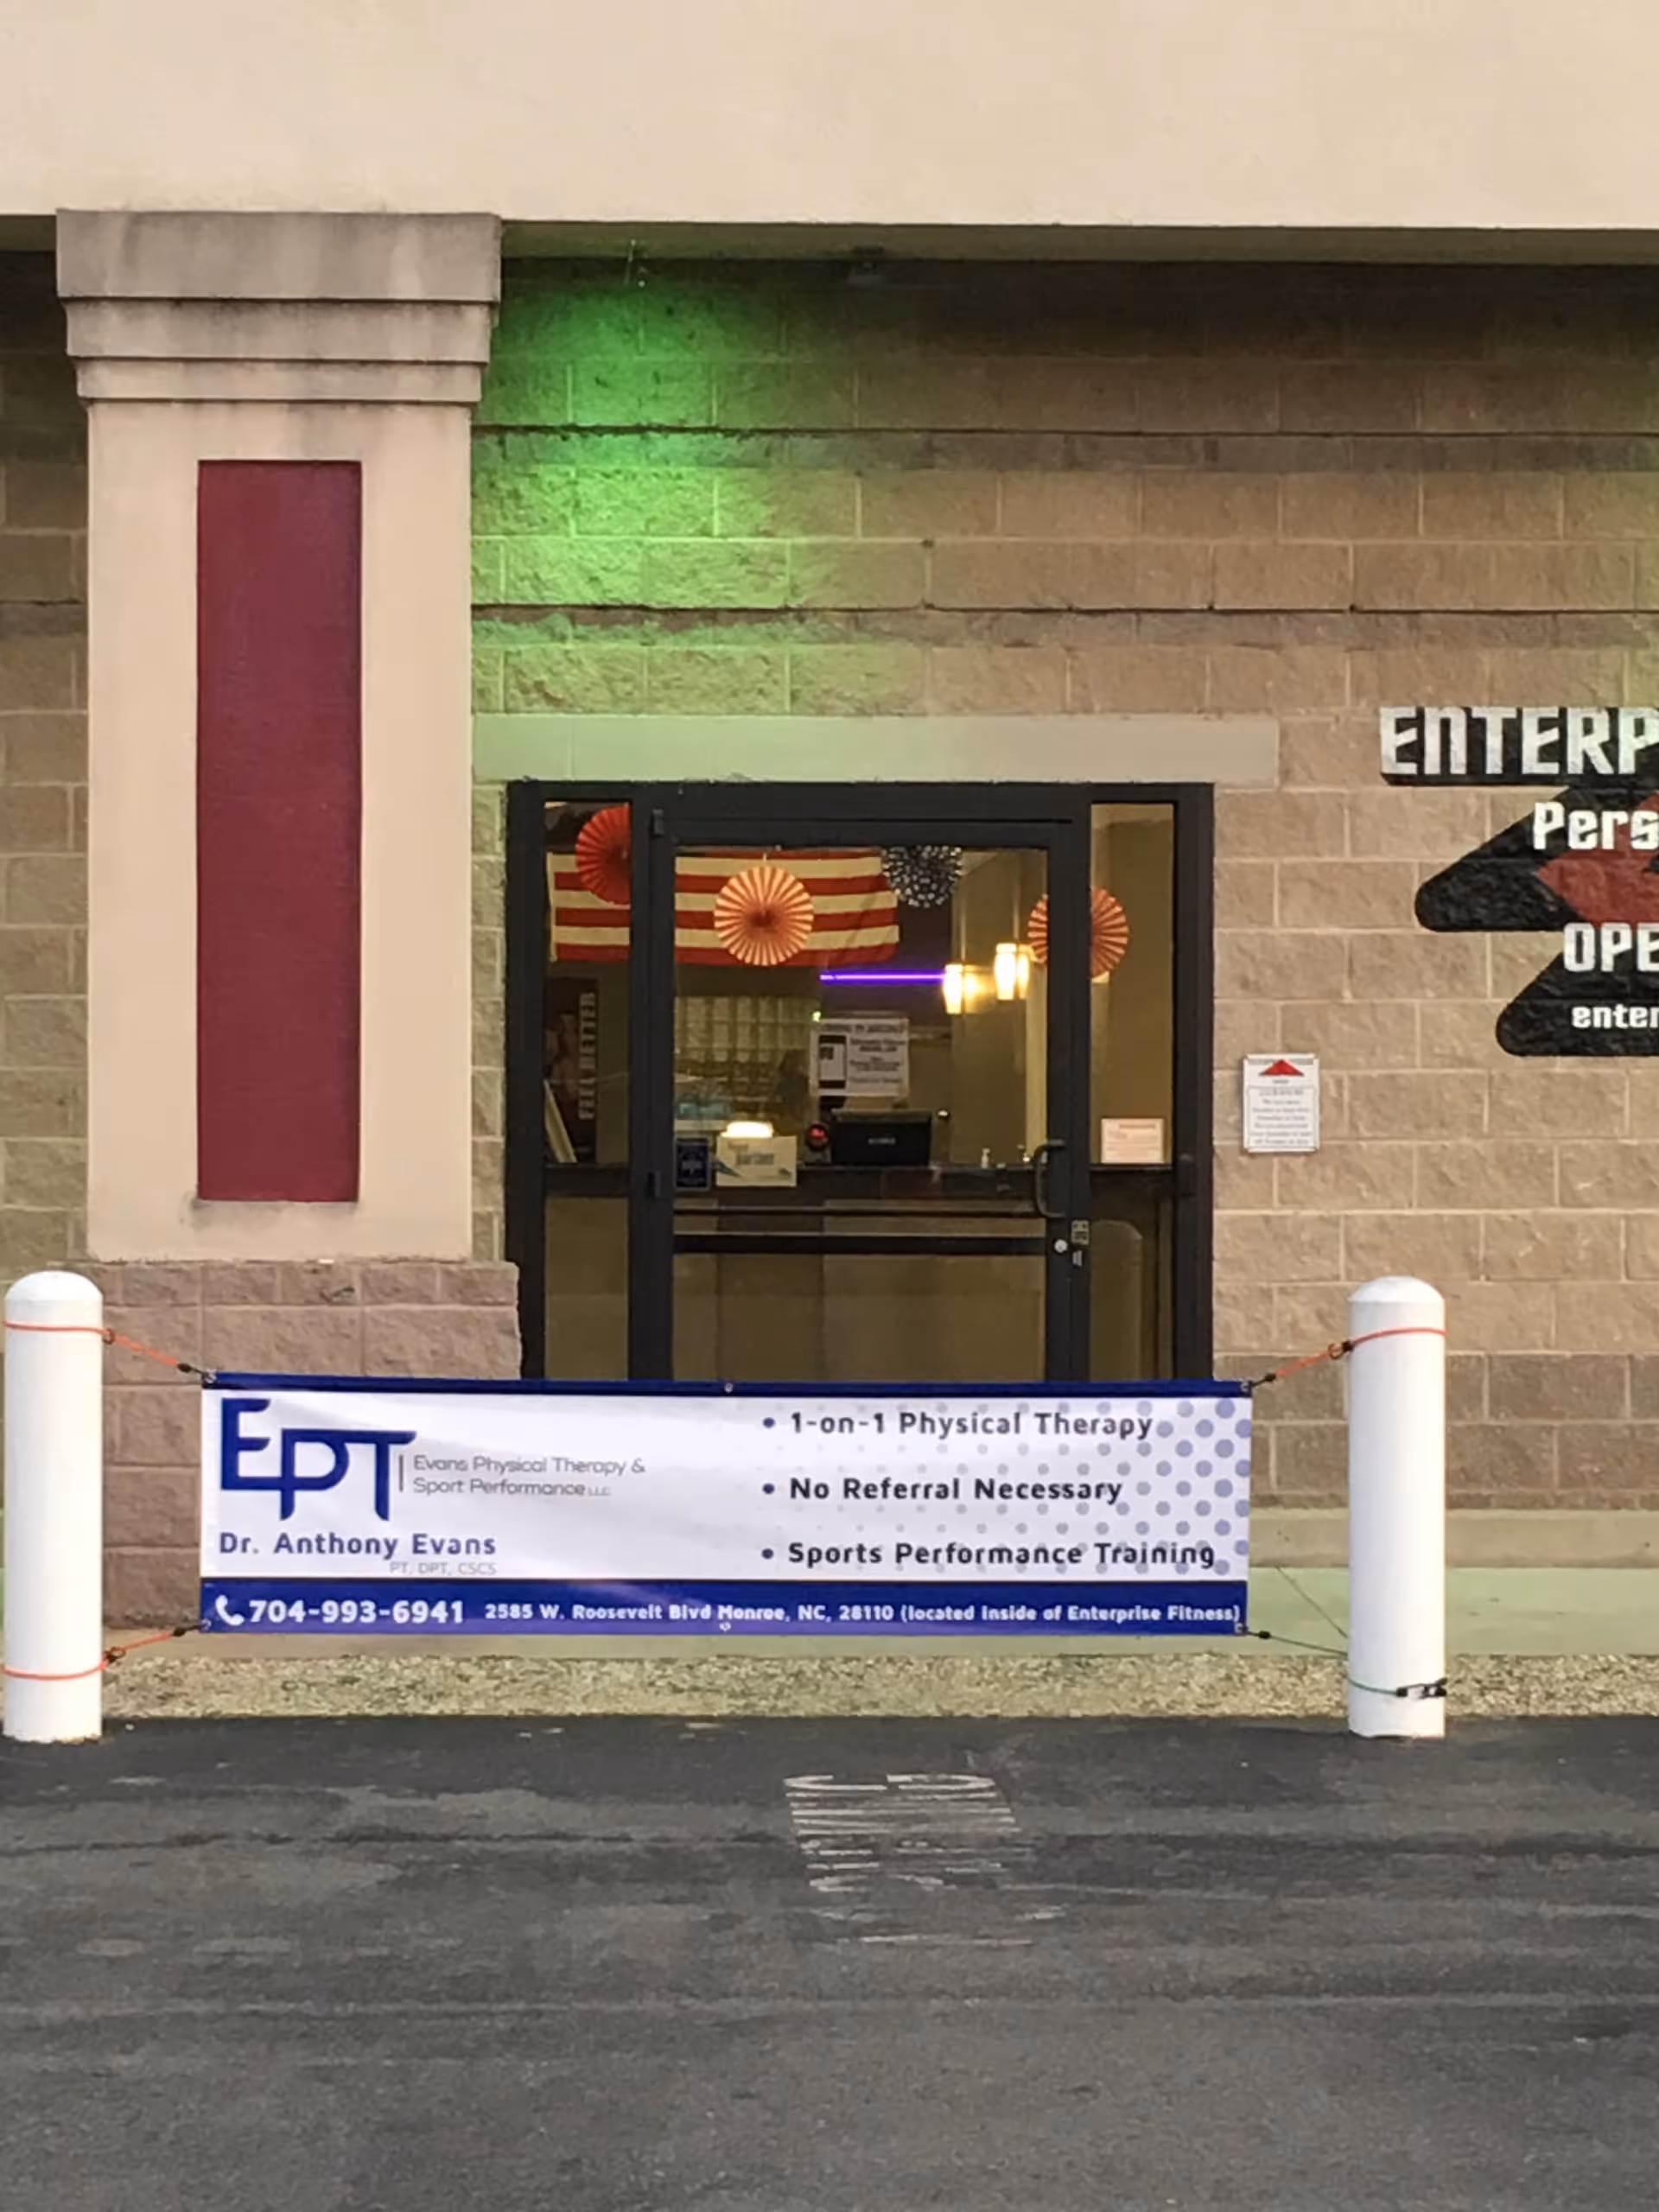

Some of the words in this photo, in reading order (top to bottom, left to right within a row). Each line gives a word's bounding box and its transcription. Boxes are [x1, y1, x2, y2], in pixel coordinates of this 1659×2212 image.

[1380, 707, 1659, 775] ENTERP
[1532, 802, 1659, 850] Pers
[1564, 923, 1659, 972] OPE
[577, 992, 596, 1065] BETTER
[790, 1413, 886, 1434] 1-on-1
[899, 1413, 1021, 1440] Physical
[1034, 1413, 1153, 1440] Therapy
[220, 1397, 416, 1521] EPT
[413, 1455, 467, 1472] Evans
[474, 1455, 546, 1476] Physical
[550, 1457, 626, 1477] Therapy
[631, 1459, 645, 1473] &
[413, 1477, 465, 1496] Sport
[470, 1478, 585, 1497] Performance
[790, 1478, 830, 1499] No
[843, 1478, 960, 1499] Referral
[974, 1478, 1122, 1504] Necessary
[219, 1533, 259, 1554] Dr.
[274, 1533, 398, 1559] Anthony
[413, 1533, 496, 1554] Evans
[789, 1542, 882, 1568] Sports
[895, 1543, 1083, 1565] Performance
[1094, 1543, 1214, 1568] Training
[390, 1562, 414, 1576] PT,
[418, 1562, 452, 1576] DPT,
[458, 1562, 497, 1575] CSCS
[248, 1599, 463, 1624] 704-993-6941
[486, 1604, 533, 1620] 2585
[540, 1605, 564, 1620] W.
[573, 1604, 663, 1621] Roosevelt
[669, 1605, 710, 1621] Blvd
[718, 1605, 790, 1623] Monroe,
[798, 1605, 831, 1623] NC,
[839, 1605, 893, 1621] 28110
[900, 1605, 974, 1624] (located
[1043, 1605, 1061, 1621] of
[1068, 1605, 1161, 1624] Enterprise
[1167, 1605, 1240, 1624] Fitness)
